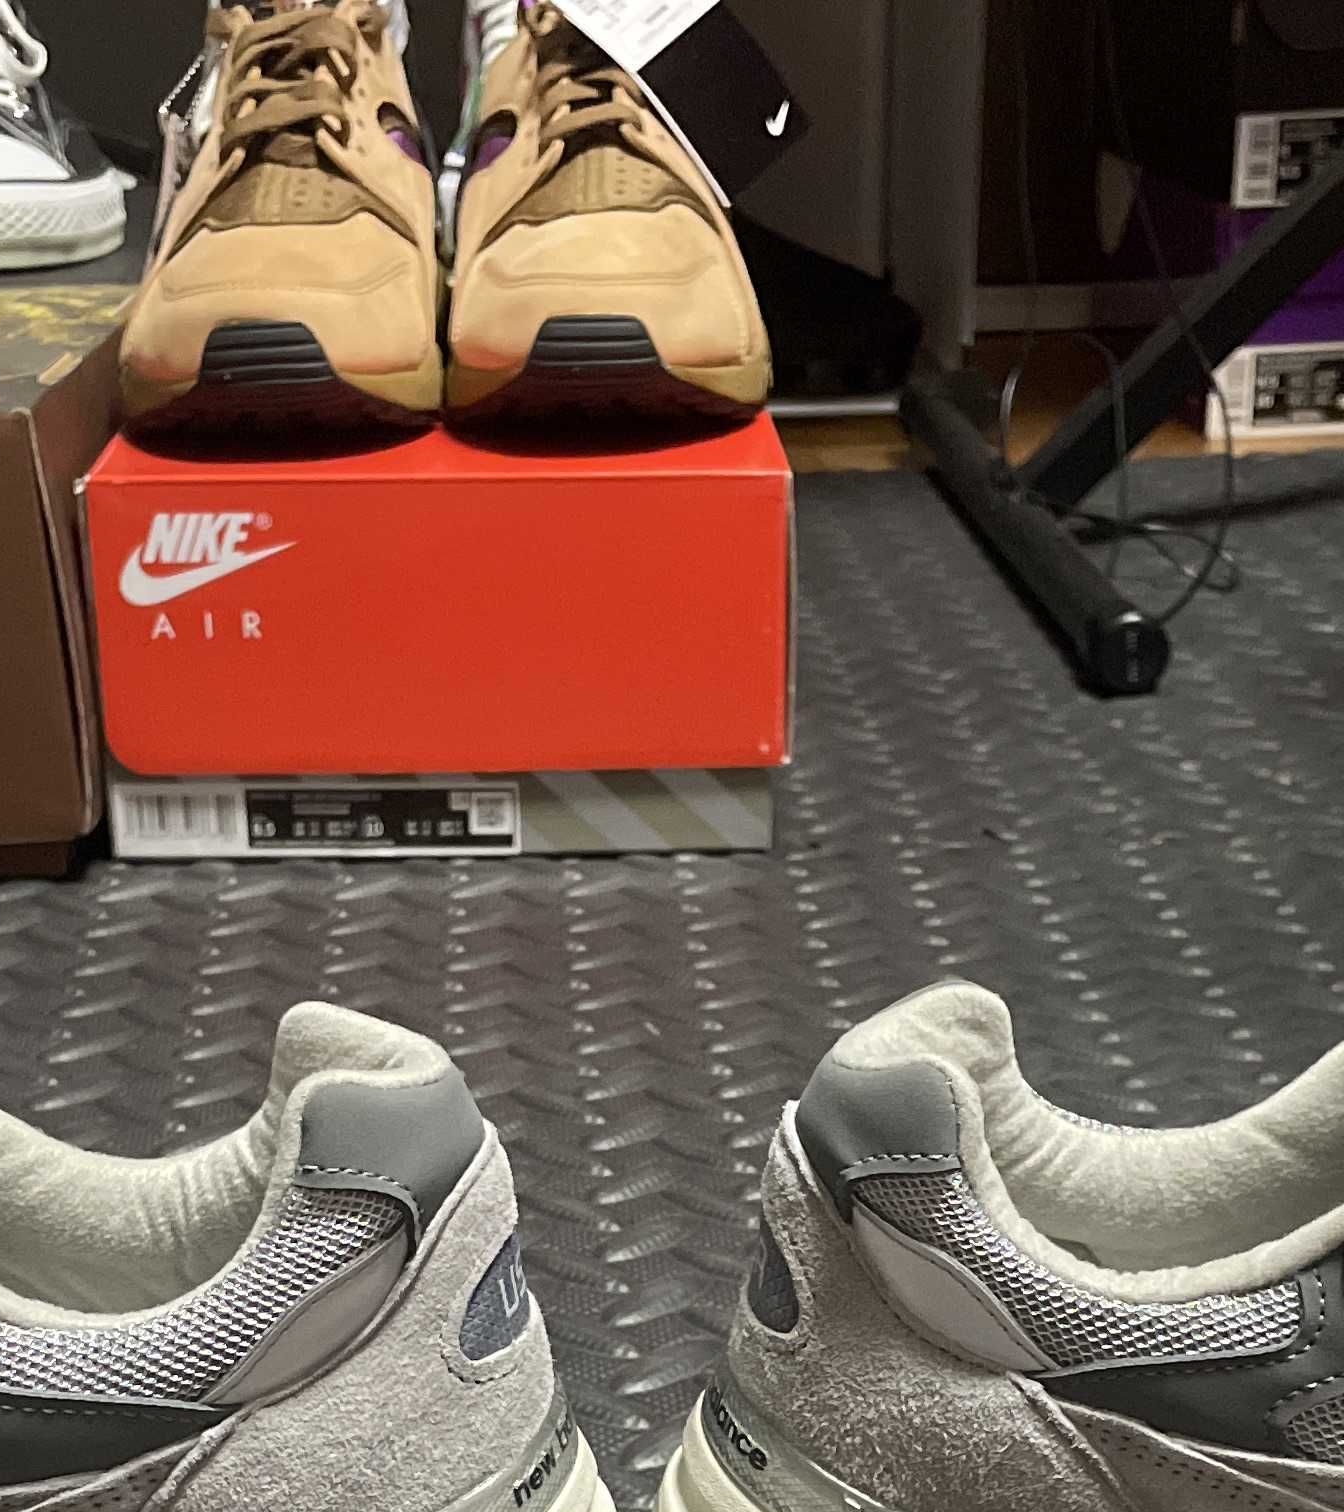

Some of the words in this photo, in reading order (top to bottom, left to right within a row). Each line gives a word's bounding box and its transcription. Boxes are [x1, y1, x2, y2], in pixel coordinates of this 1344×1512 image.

[142, 511, 254, 564] NIKE
[150, 610, 263, 640] AIR
[513, 1446, 556, 1508] new
